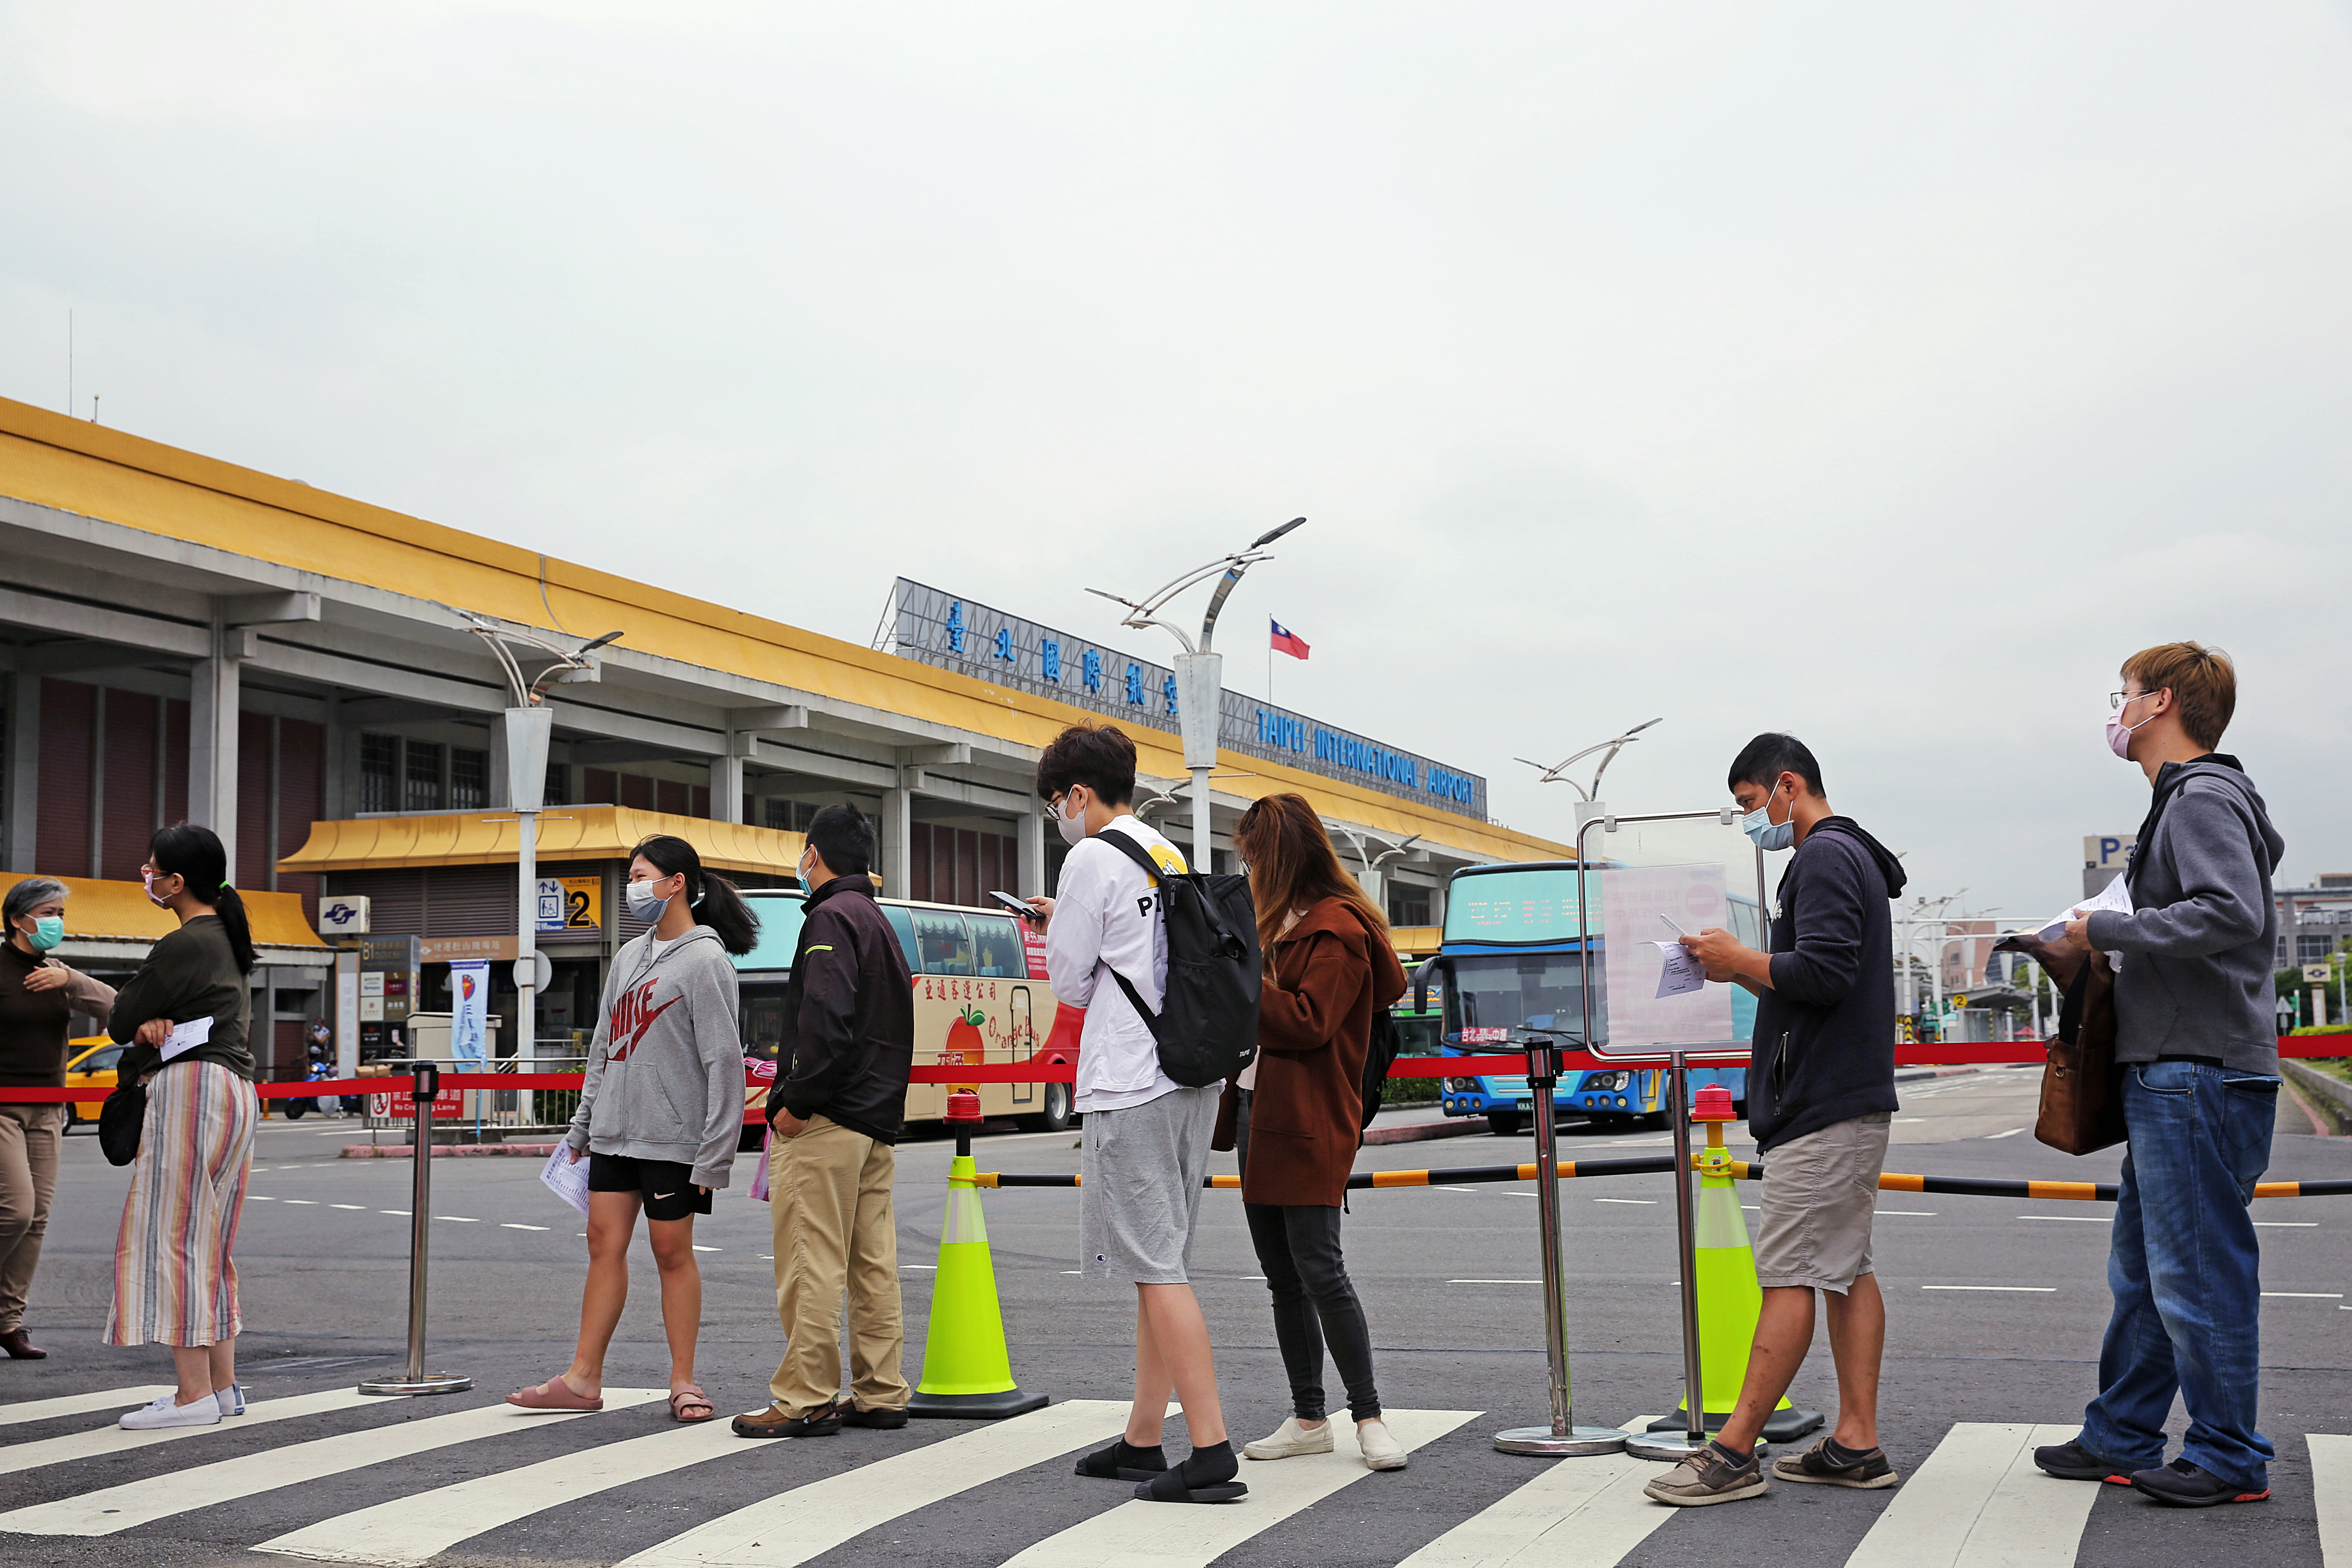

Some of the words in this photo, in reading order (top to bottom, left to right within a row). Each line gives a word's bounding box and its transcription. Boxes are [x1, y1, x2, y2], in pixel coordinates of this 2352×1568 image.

[1256, 708, 1305, 752] TAIPEI
[1314, 728, 1419, 788] INTERNATIONAL
[1427, 766, 1474, 804] AIRPORT
[2100, 837, 2121, 864] P
[568, 891, 591, 928] 2
[609, 977, 659, 1048] NIKE
[1956, 996, 1964, 1006] 2
[989, 1015, 1023, 1049] Orange
[1025, 1015, 1040, 1047] Bus
[1462, 1028, 1476, 1042] 台北
[392, 1089, 461, 1101] 禁止車道
